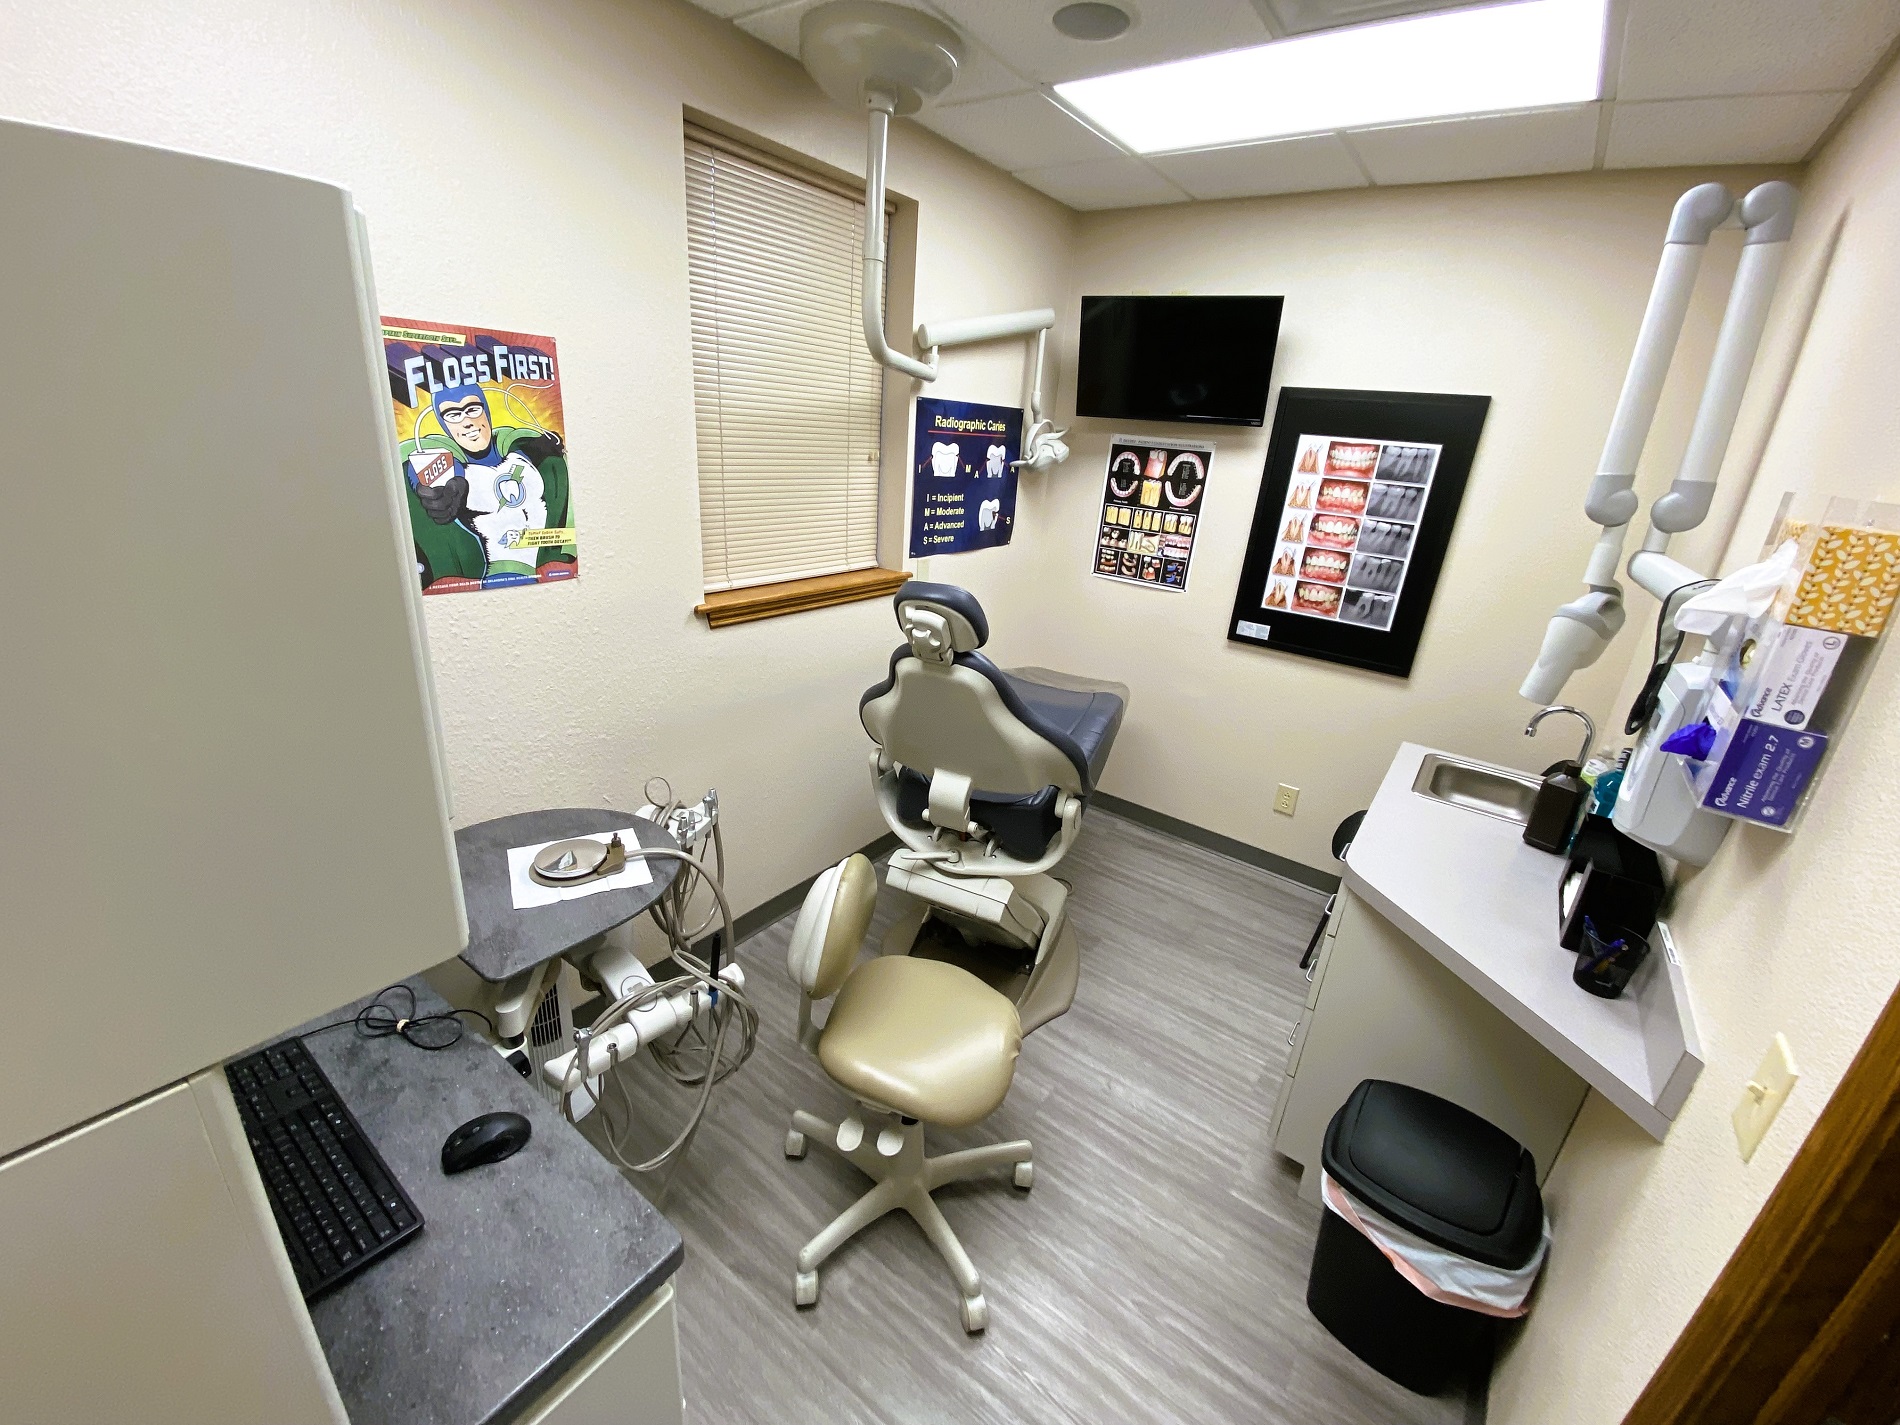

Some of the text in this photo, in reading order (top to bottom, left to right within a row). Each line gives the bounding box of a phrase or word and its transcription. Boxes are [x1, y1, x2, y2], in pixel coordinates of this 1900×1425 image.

[404, 345, 555, 409] FLOSS FIRST!
[935, 415, 1006, 432] Radiographic Caries
[423, 455, 447, 483] FLOSS
[965, 464, 972, 473] M
[974, 470, 979, 478] A
[937, 493, 964, 503] Incipient
[924, 508, 930, 516] M
[936, 507, 965, 515] Moderate
[923, 522, 929, 531] A
[934, 520, 965, 529] Advanced
[923, 536, 928, 545] S
[933, 535, 954, 543] Severe
[1750, 687, 1773, 717] Advance
[1771, 682, 1793, 712] LATEX
[1736, 735, 1779, 809] Nitrile exam 2.7
[1714, 777, 1737, 807] Advance
